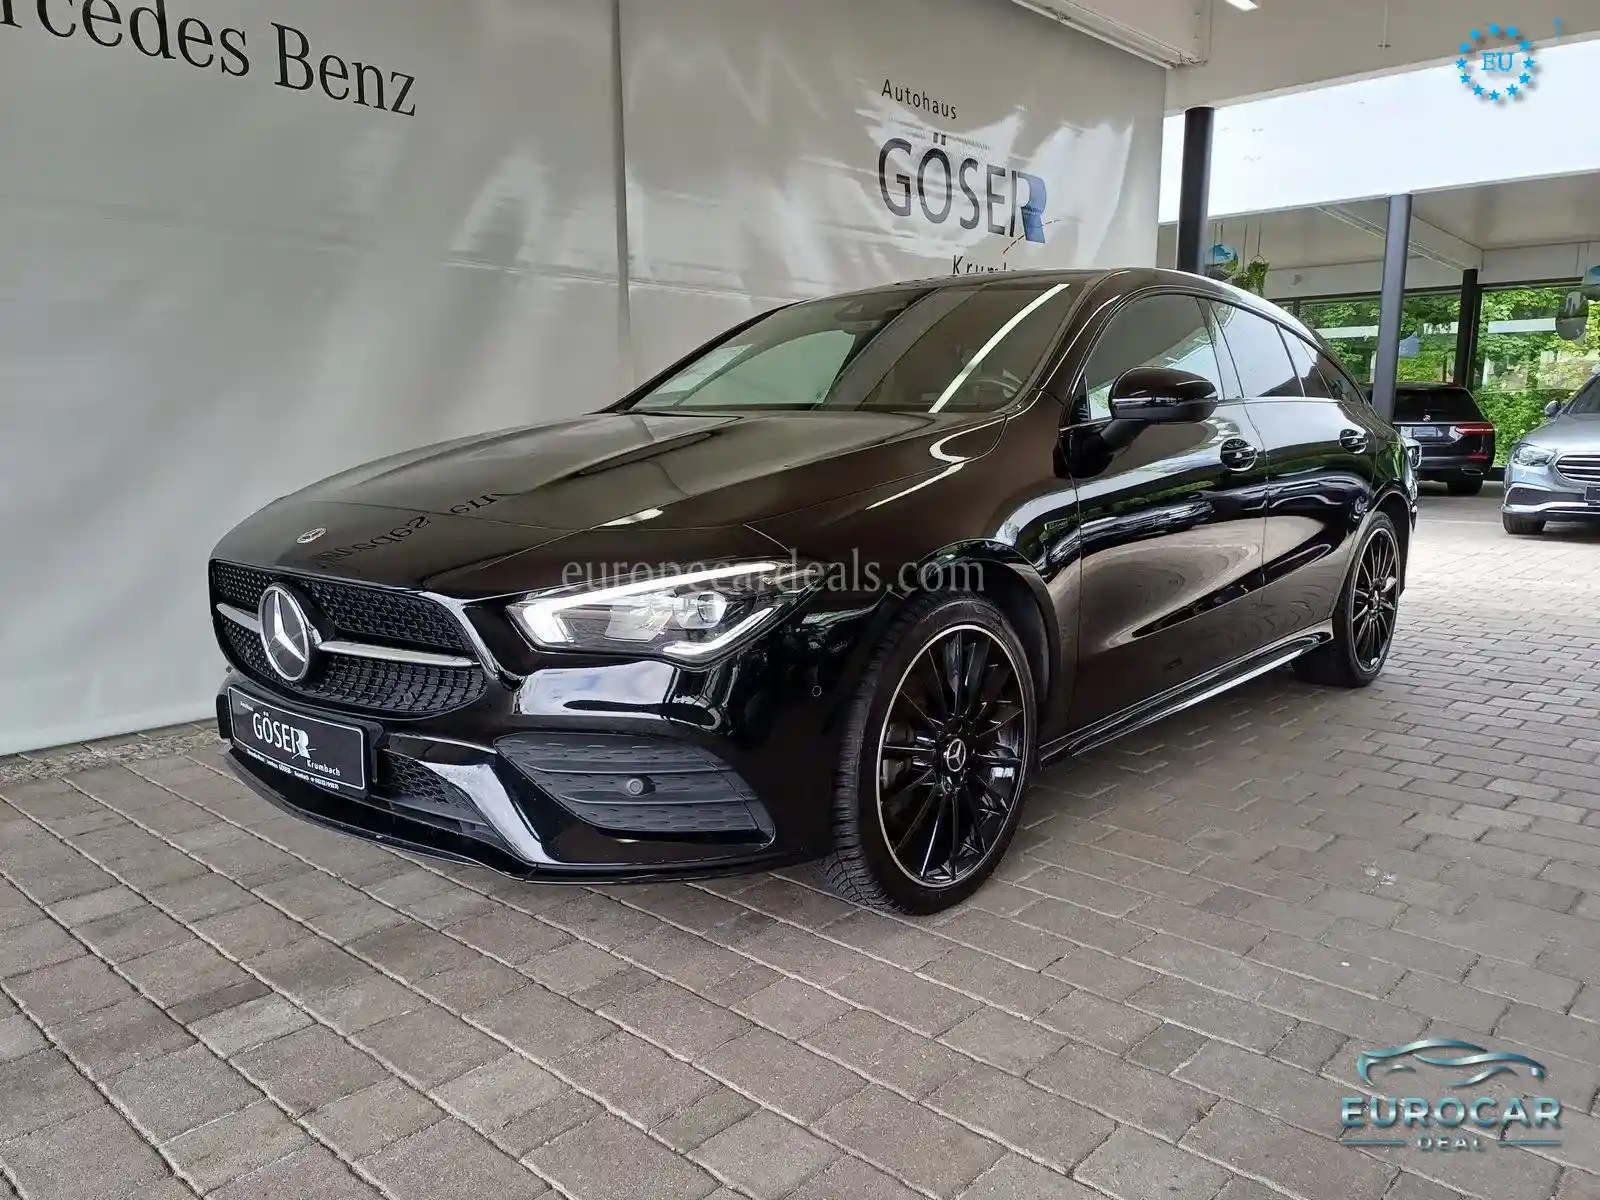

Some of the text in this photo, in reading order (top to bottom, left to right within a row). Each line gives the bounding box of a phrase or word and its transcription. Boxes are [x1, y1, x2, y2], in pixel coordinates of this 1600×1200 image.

[270, 22, 416, 117] Benz
[881, 79, 957, 120] Autohaus
[878, 131, 1048, 244] GÖSER
[253, 711, 311, 759] GÖSER
[306, 759, 341, 777] Krumbach
